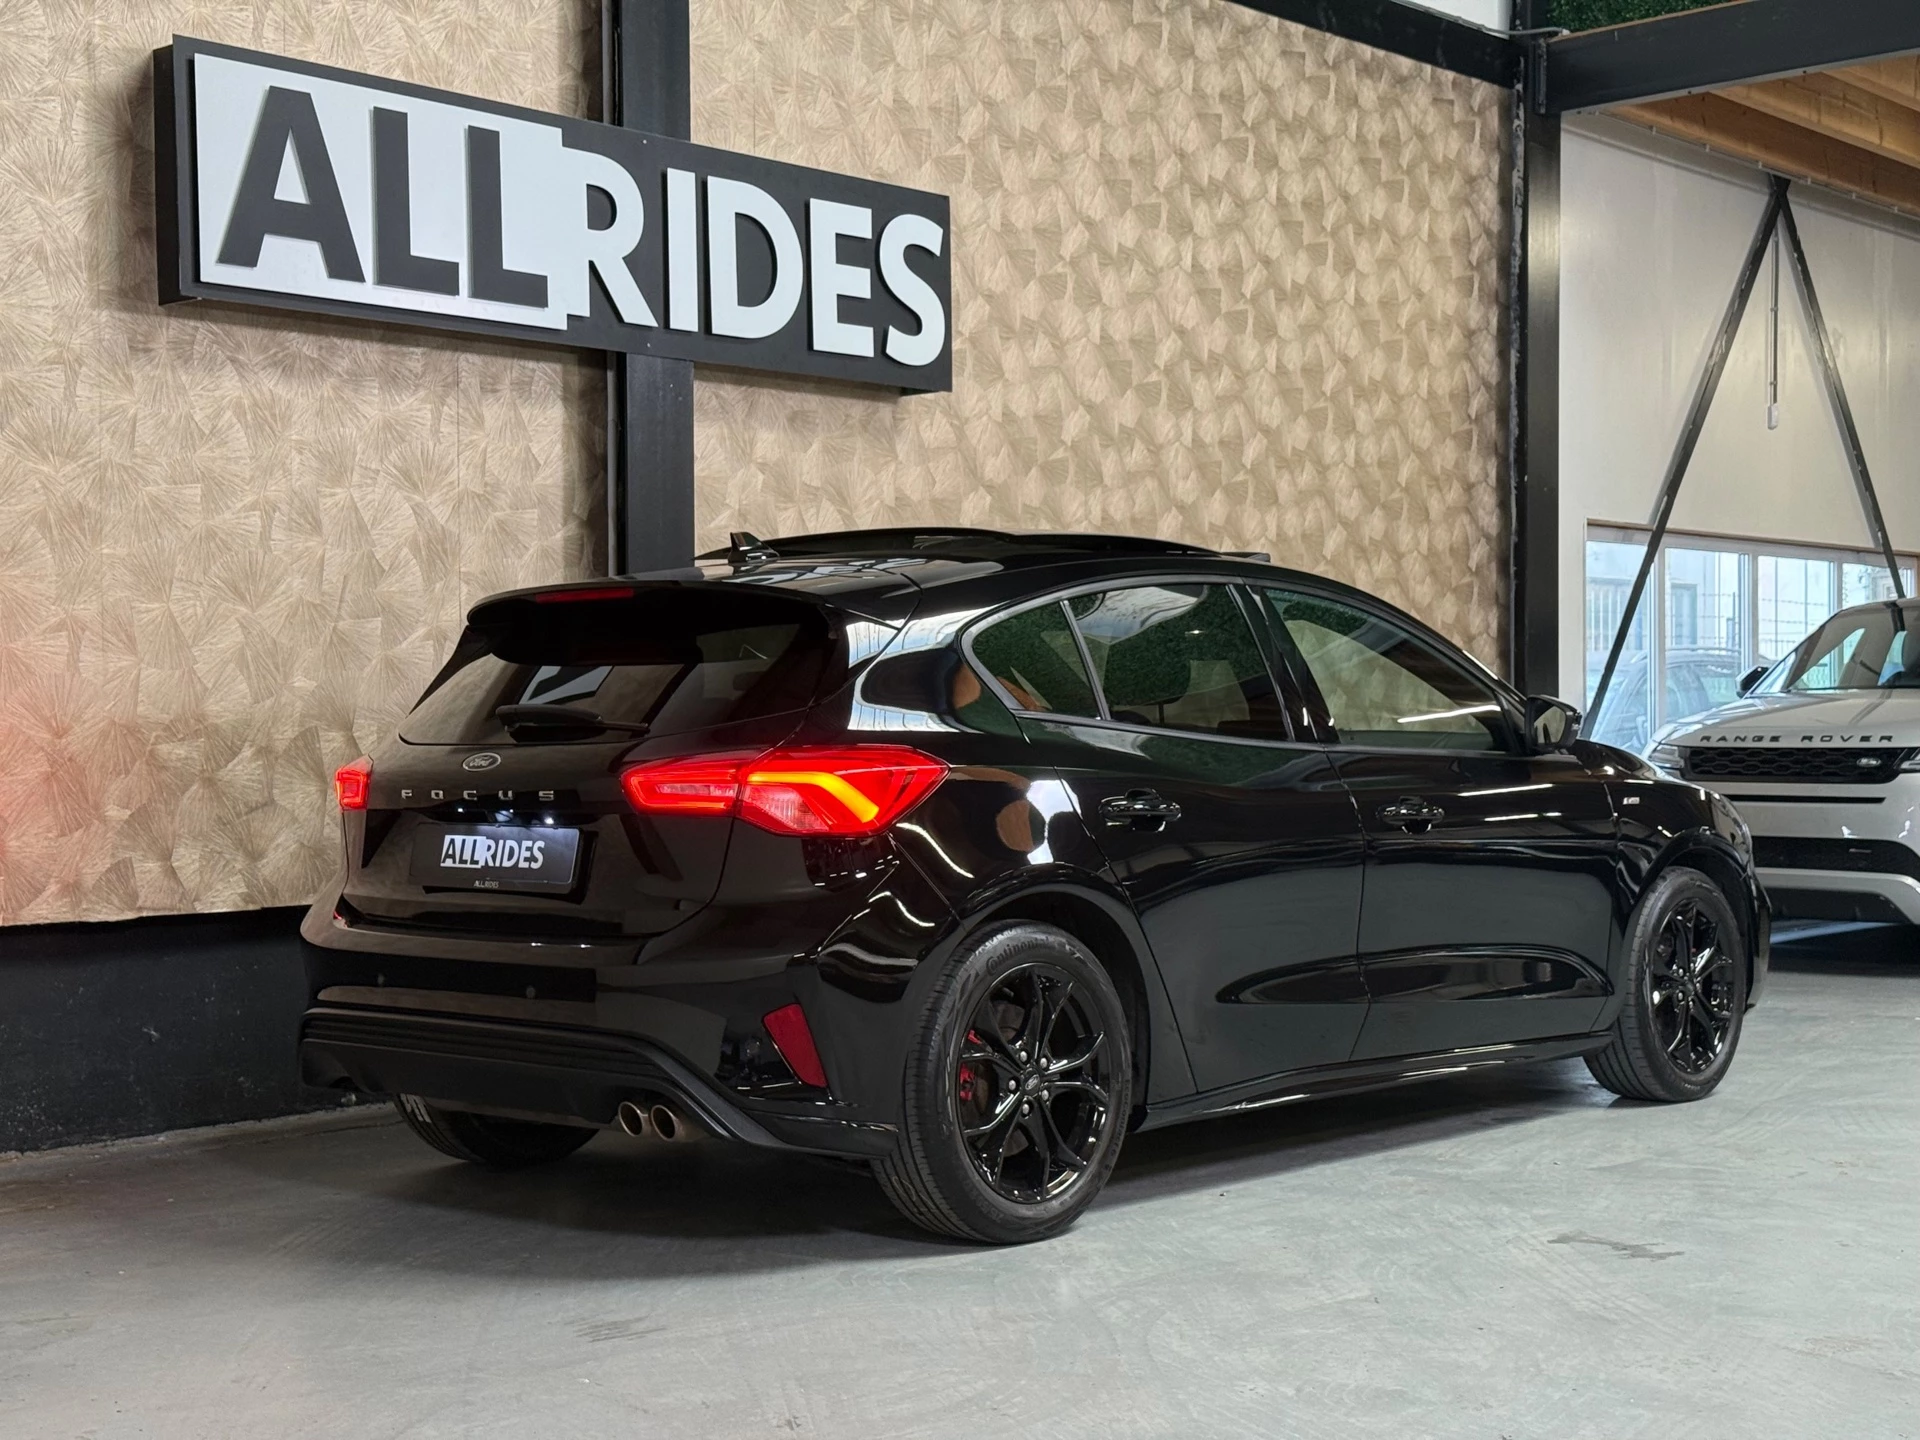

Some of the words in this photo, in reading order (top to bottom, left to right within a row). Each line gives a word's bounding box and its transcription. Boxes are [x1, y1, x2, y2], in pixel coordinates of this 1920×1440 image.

[1700, 735, 1782, 743] RANGE
[1801, 735, 1894, 743] ROVER
[401, 789, 555, 801] FOCUS
